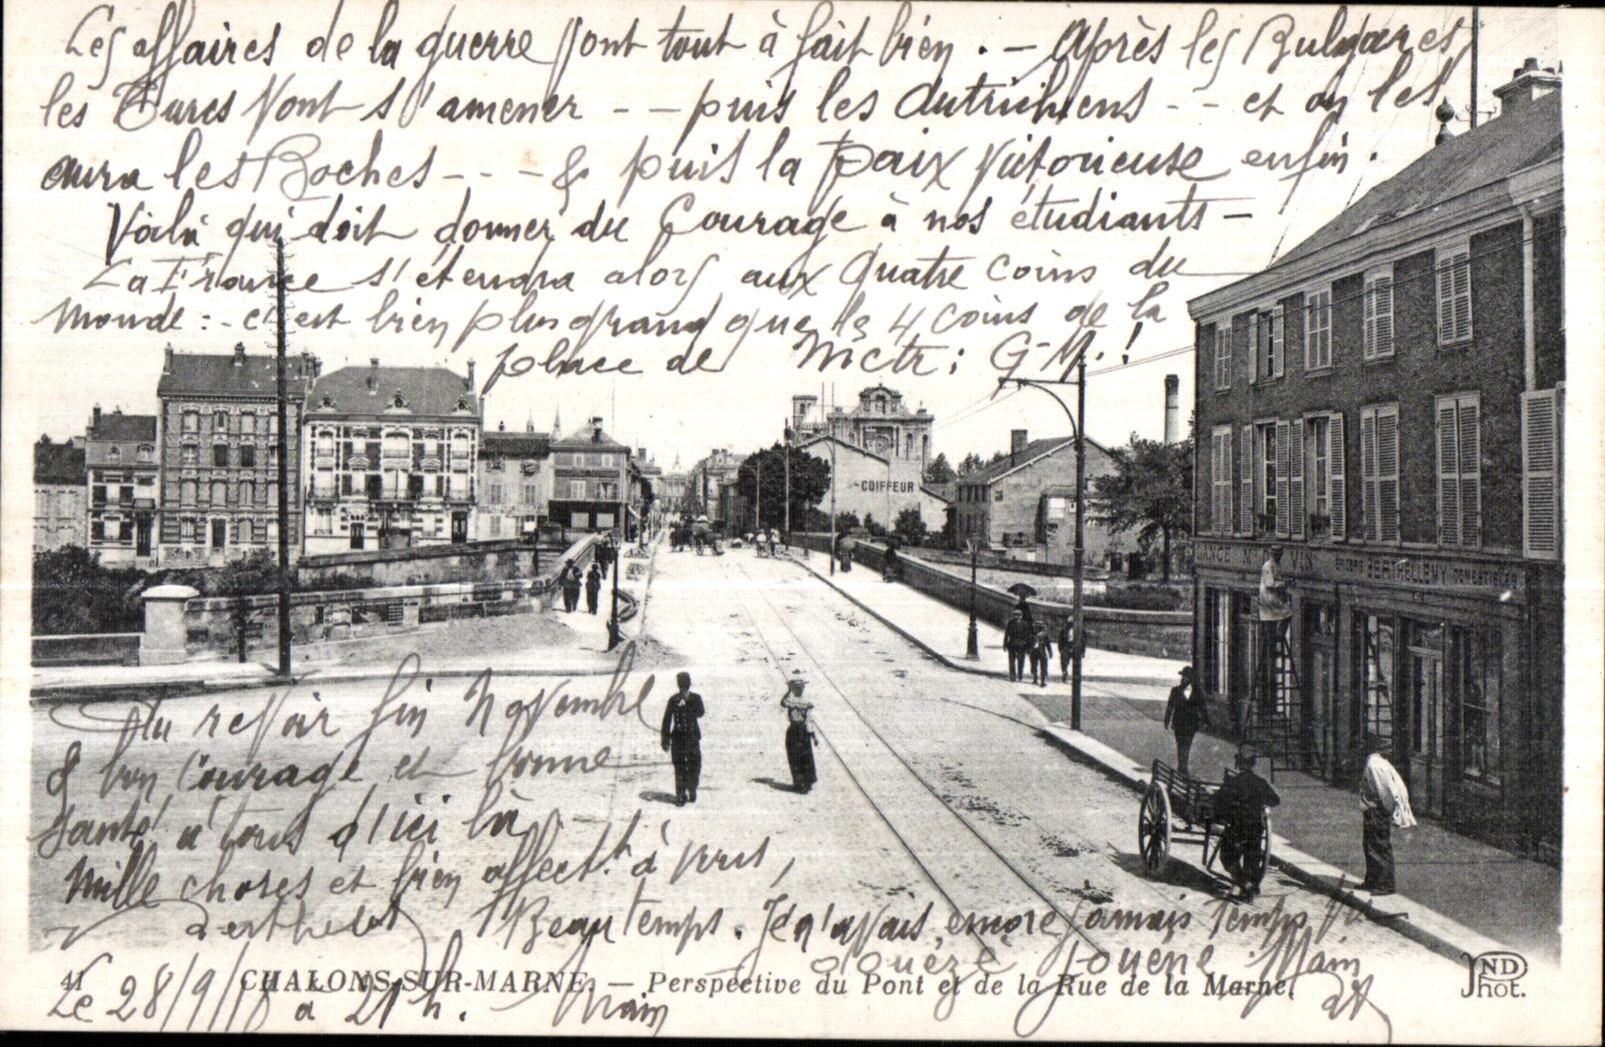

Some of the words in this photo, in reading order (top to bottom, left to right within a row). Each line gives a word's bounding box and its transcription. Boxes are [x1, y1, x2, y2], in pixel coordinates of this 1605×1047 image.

[132, 0, 282, 113] affaires
[307, 0, 355, 62] de
[368, 0, 403, 69] la
[399, 4, 558, 128] guerre
[657, 5, 746, 63] tout
[758, 9, 788, 58] à
[769, 0, 873, 106] fait
[1181, 8, 1242, 92] les
[40, 72, 89, 128] les
[673, 79, 796, 157] puis
[817, 66, 878, 123] les
[1243, 83, 1284, 121] et
[1367, 41, 1472, 112] les
[163, 127, 247, 192] les
[619, 128, 751, 208] puis
[756, 126, 802, 186] la
[810, 129, 969, 214] paix
[289, 193, 418, 246] doit
[434, 187, 554, 244] donner
[570, 199, 629, 243] du
[880, 191, 909, 232] à
[923, 194, 993, 235] nos
[151, 252, 355, 294] France
[604, 221, 720, 316] alors
[741, 262, 833, 300] aux
[366, 289, 449, 349] bien
[451, 289, 560, 352] plus
[725, 308, 812, 371] que
[888, 302, 927, 345] 4
[1127, 280, 1168, 323] la
[482, 338, 644, 393] place
[861, 480, 915, 493] COIFFEUR
[180, 842, 314, 904] choses
[329, 865, 377, 895] et
